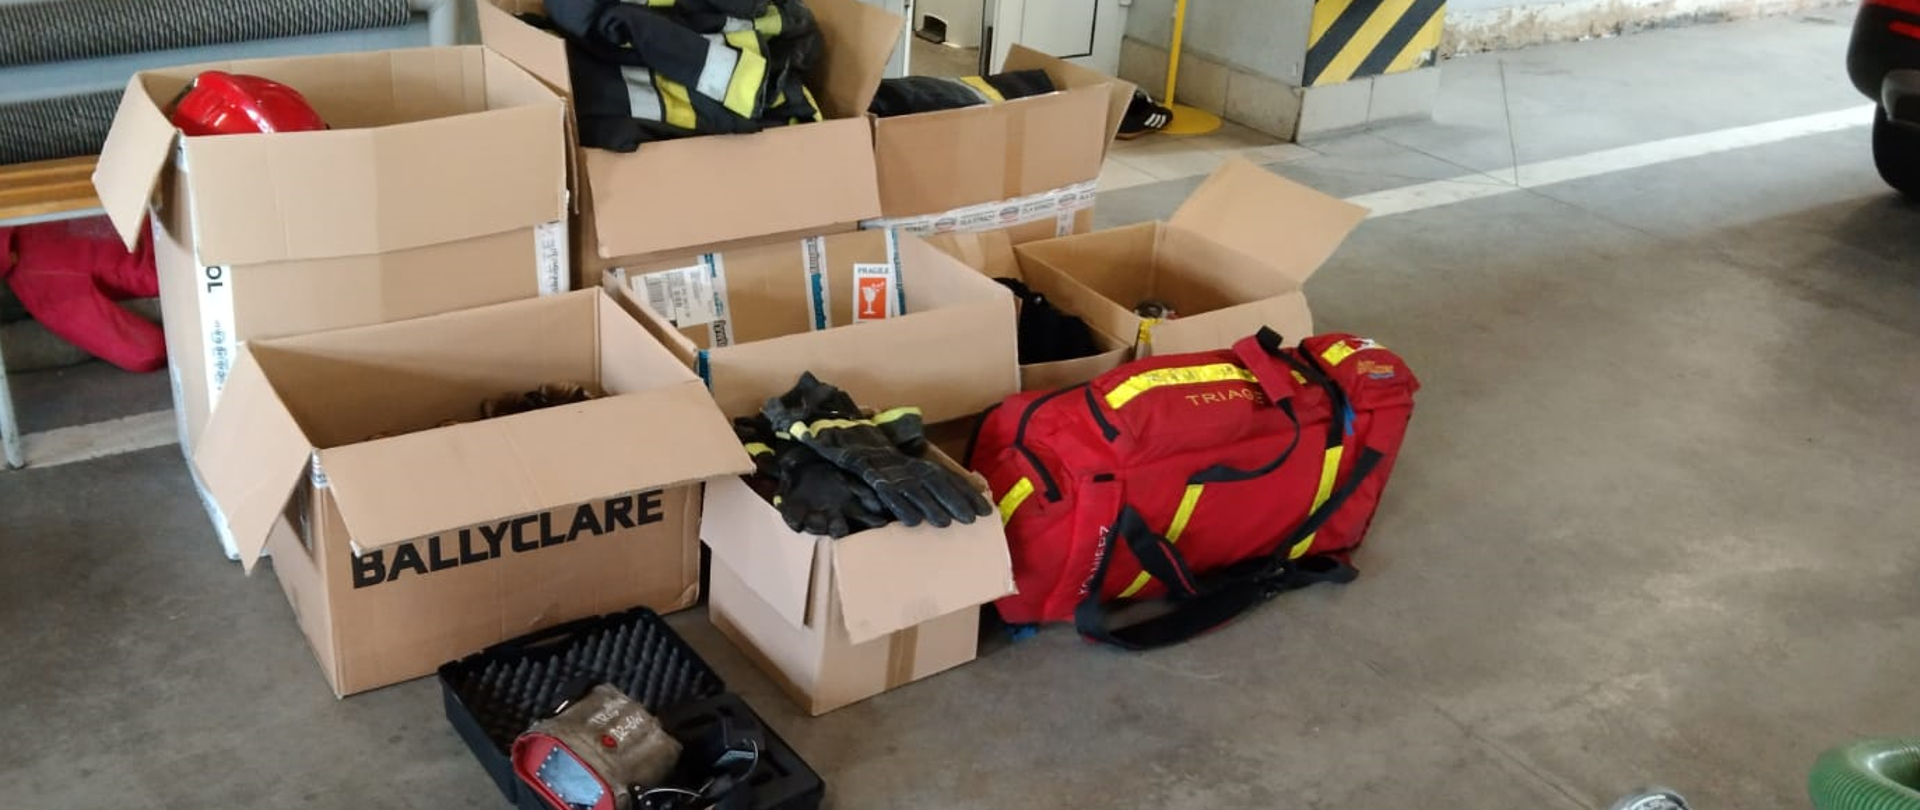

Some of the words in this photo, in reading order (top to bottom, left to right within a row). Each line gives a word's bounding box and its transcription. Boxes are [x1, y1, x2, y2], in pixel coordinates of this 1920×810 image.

[857, 266, 889, 274] FRAGILE
[1185, 388, 1264, 407] TRIAGE
[352, 489, 664, 589] BALLYCLARE
